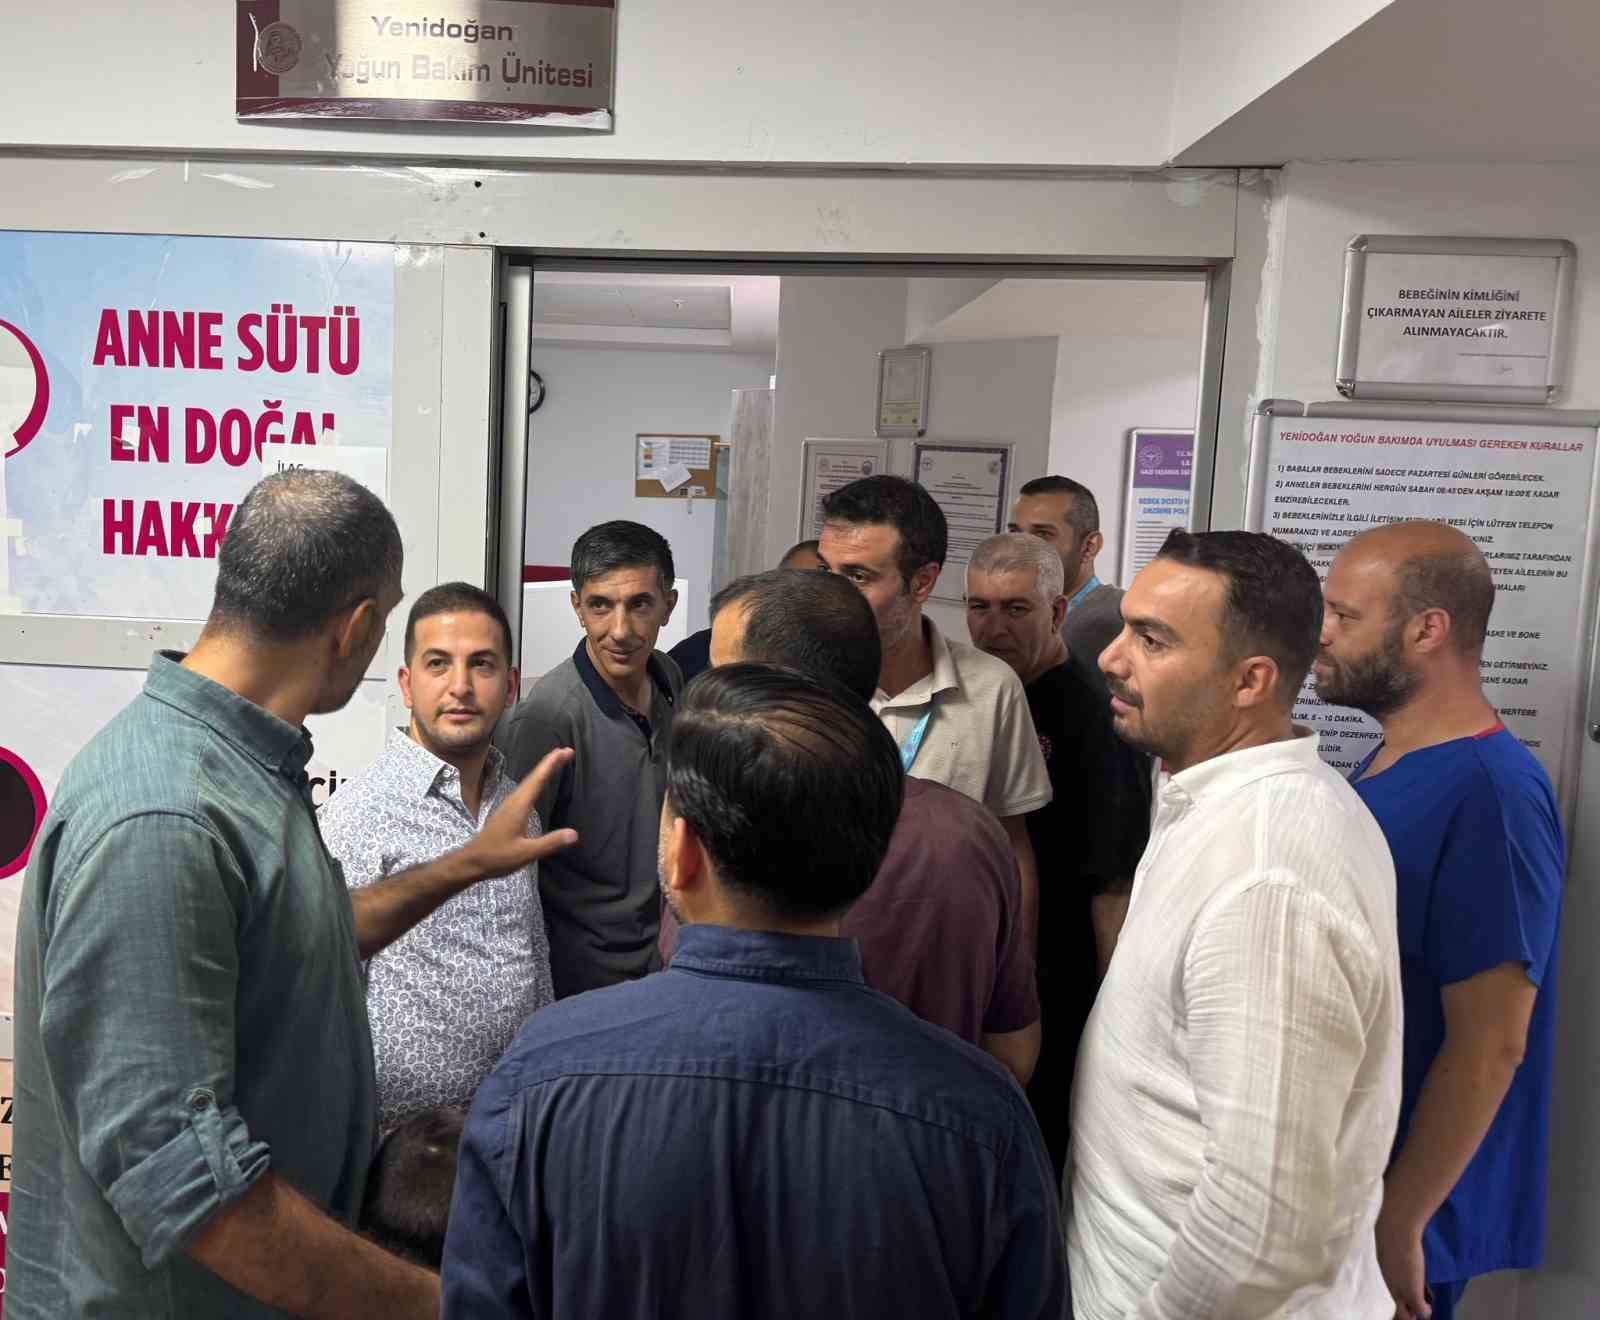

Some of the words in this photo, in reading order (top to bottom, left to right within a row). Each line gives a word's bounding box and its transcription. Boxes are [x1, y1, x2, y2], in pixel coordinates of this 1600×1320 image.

[371, 15, 513, 43] Yenidoğan
[325, 52, 401, 84] Yoğun
[410, 54, 491, 83] Bakım
[501, 51, 594, 89] Ünitesi
[1399, 288, 1460, 300] BEBEĞİNİN
[1463, 290, 1519, 302] KİMLİĞİNİ
[1367, 307, 1446, 321] ÇIKARMAYAN
[1448, 307, 1492, 320] AİLELER
[1494, 308, 1547, 321] ZİYARETE
[92, 308, 223, 370] ANNE
[237, 303, 361, 376] SÜTÜ
[1402, 325, 1508, 339] ALINMAYACAKTIR.
[110, 404, 170, 463] EN
[184, 399, 336, 467] DOĞA
[1279, 431, 1338, 443] YENİDOĞAN
[1341, 433, 1375, 444] YOĞUN
[1377, 436, 1423, 446] BAKIMDA
[1426, 437, 1476, 448] UYULMASI
[1480, 439, 1527, 450] GEREKEN
[1530, 441, 1584, 452] KURALLAR
[102, 498, 241, 559] HAKK
